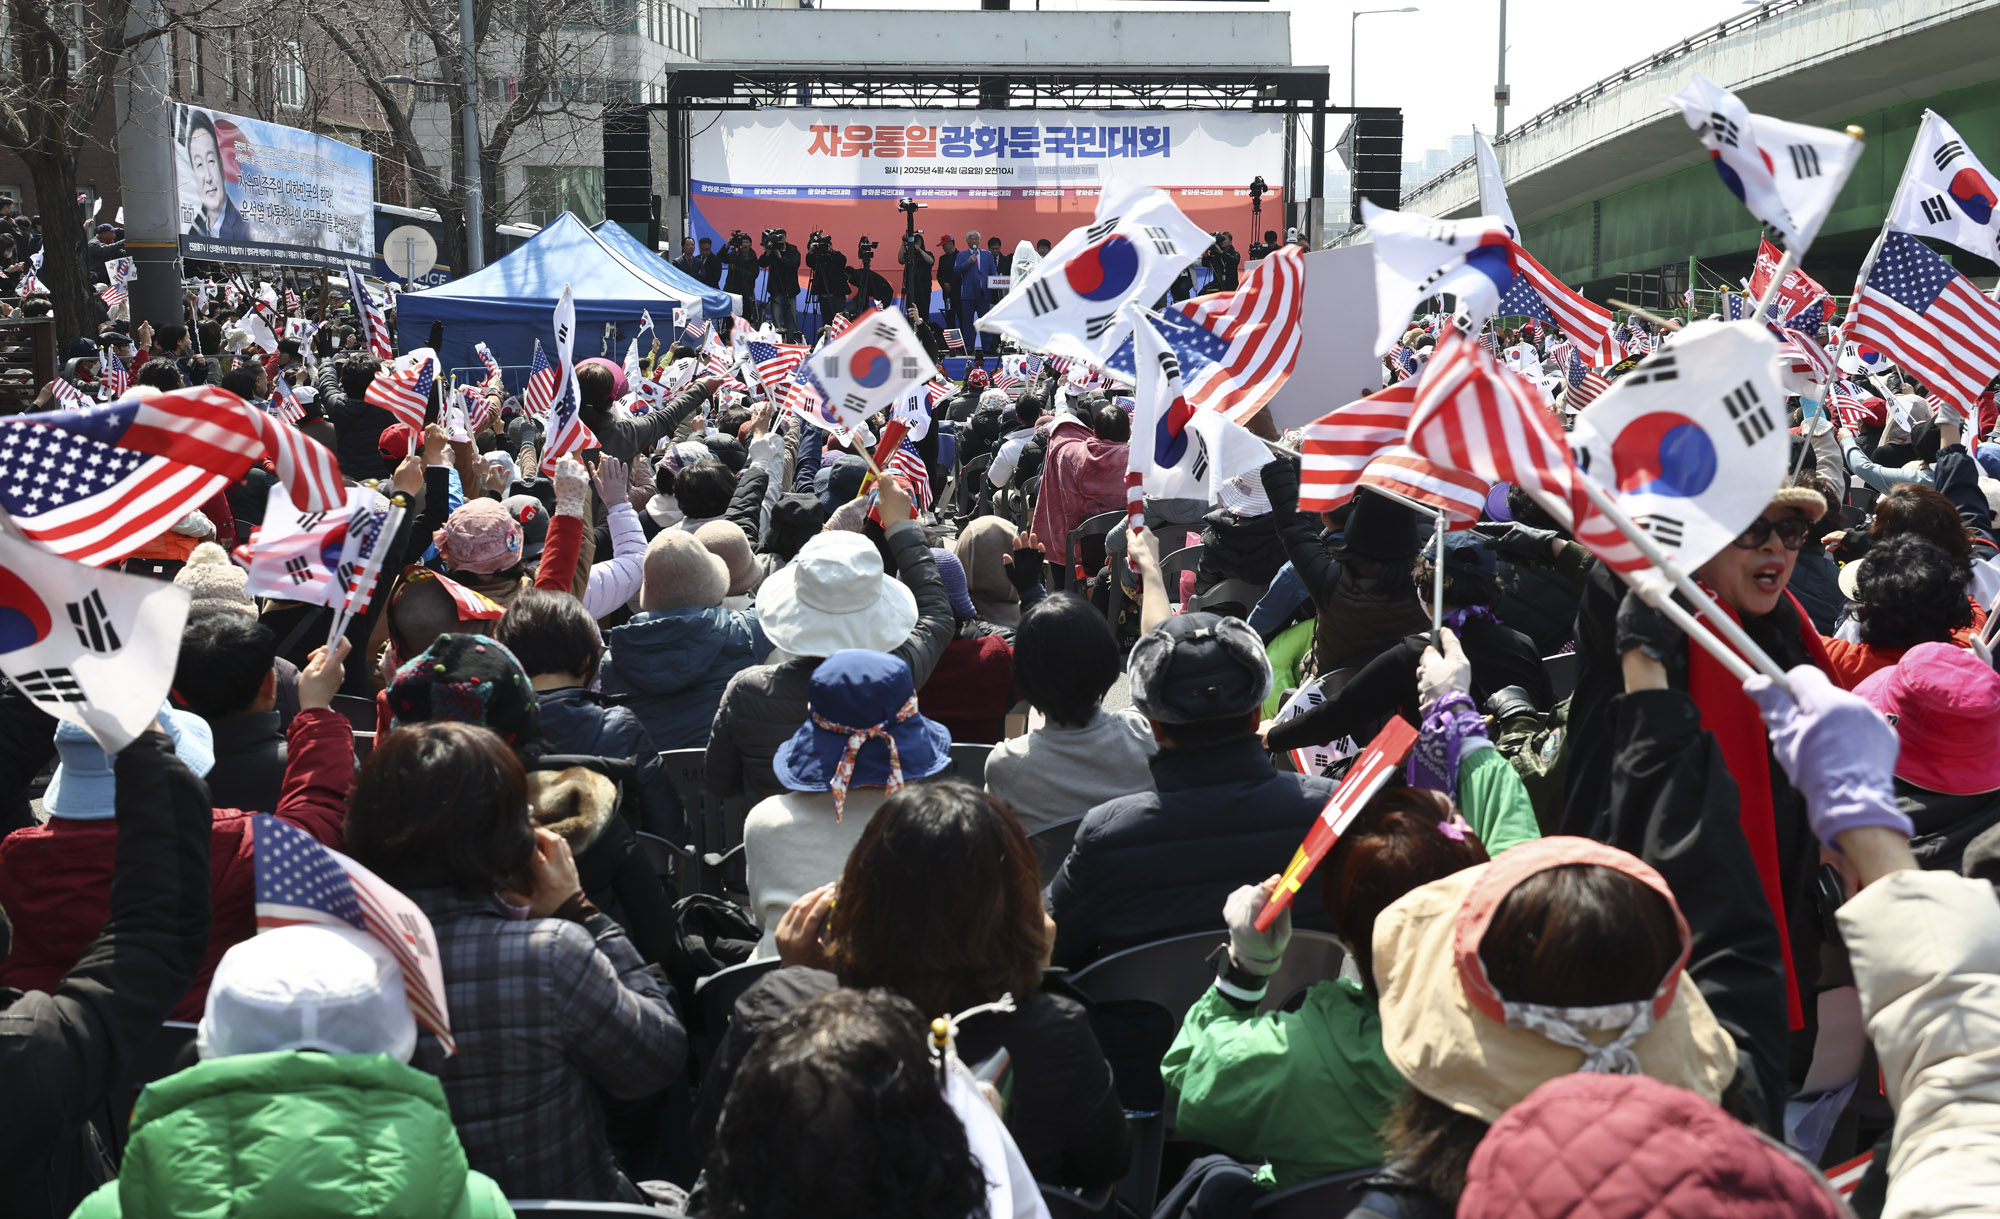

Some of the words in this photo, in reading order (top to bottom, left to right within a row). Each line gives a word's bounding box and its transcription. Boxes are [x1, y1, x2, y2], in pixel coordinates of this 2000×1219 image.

[807, 125, 936, 157] 자유통일
[884, 166, 898, 175] 일시
[903, 166, 930, 174] 2025년
[931, 166, 944, 175] 4월
[945, 166, 957, 175] 4일
[959, 166, 983, 175] (금요일)
[237, 173, 284, 198] 자유민주주의
[286, 179, 319, 204] 대한민국의
[240, 199, 264, 223] 윤석열
[266, 202, 301, 227] 대통령님의
